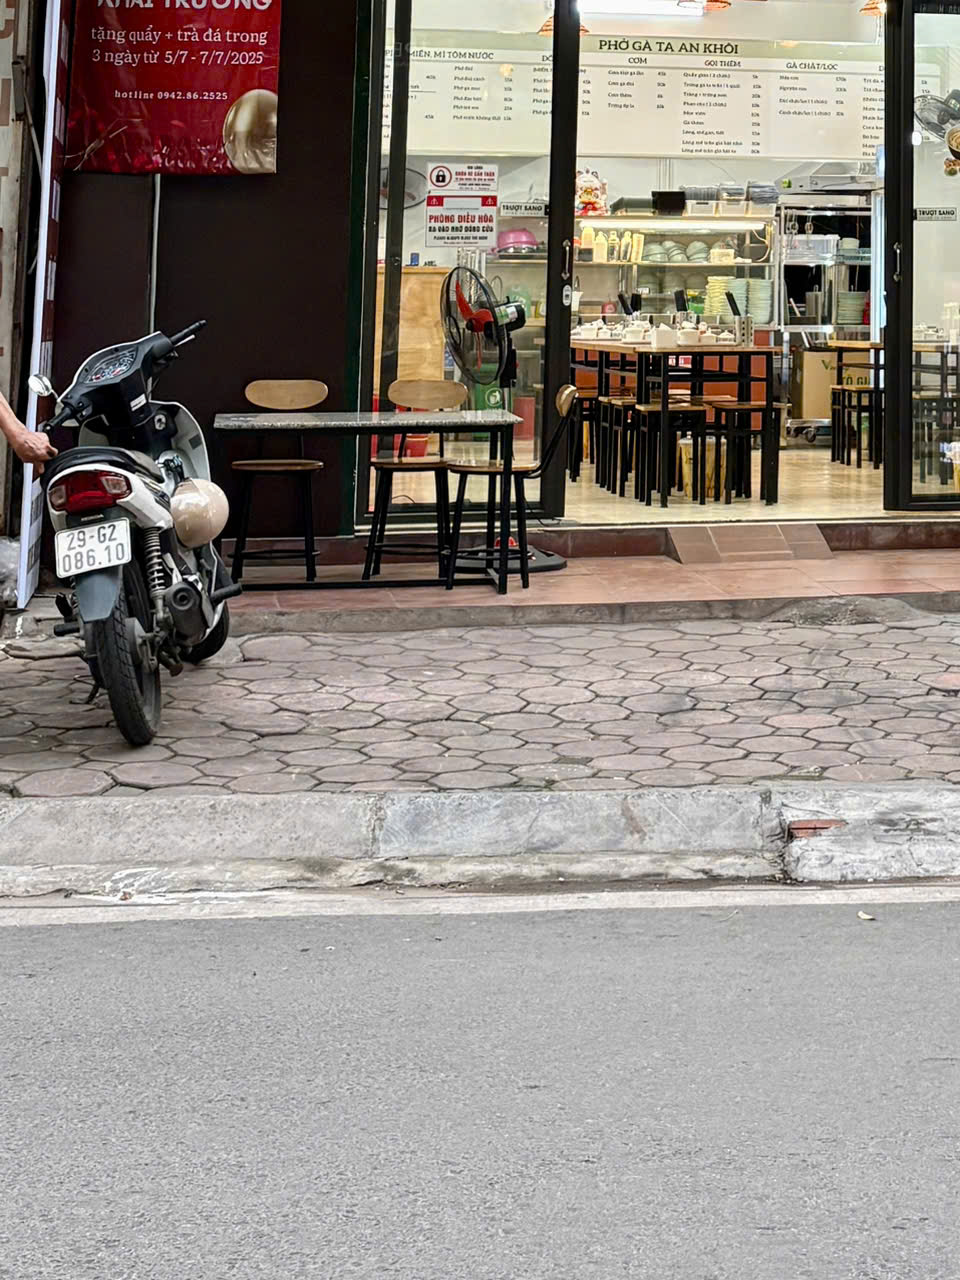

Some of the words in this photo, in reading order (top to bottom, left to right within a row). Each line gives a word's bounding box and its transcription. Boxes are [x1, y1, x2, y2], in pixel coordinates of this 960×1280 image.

[91, 27, 126, 45] tặng
[128, 25, 162, 45] quẩy
[164, 31, 174, 40] +
[177, 28, 200, 42] trà
[202, 28, 222, 43] đá
[225, 30, 269, 46] trong
[598, 37, 630, 52] PHỞ
[631, 39, 653, 52] GÀ
[655, 41, 675, 53] TA
[677, 42, 700, 54] AN
[702, 43, 739, 55] KHÔI
[92, 48, 101, 62] 3
[104, 48, 141, 67] ngày
[143, 49, 160, 64] từ
[164, 50, 189, 65] 5/7
[199, 50, 264, 66] 7/7/2025
[114, 89, 155, 100] hotline
[156, 91, 229, 101] 0942.86.2525
[66, 523, 118, 552] 29-G2
[62, 542, 125, 573] 086.10
